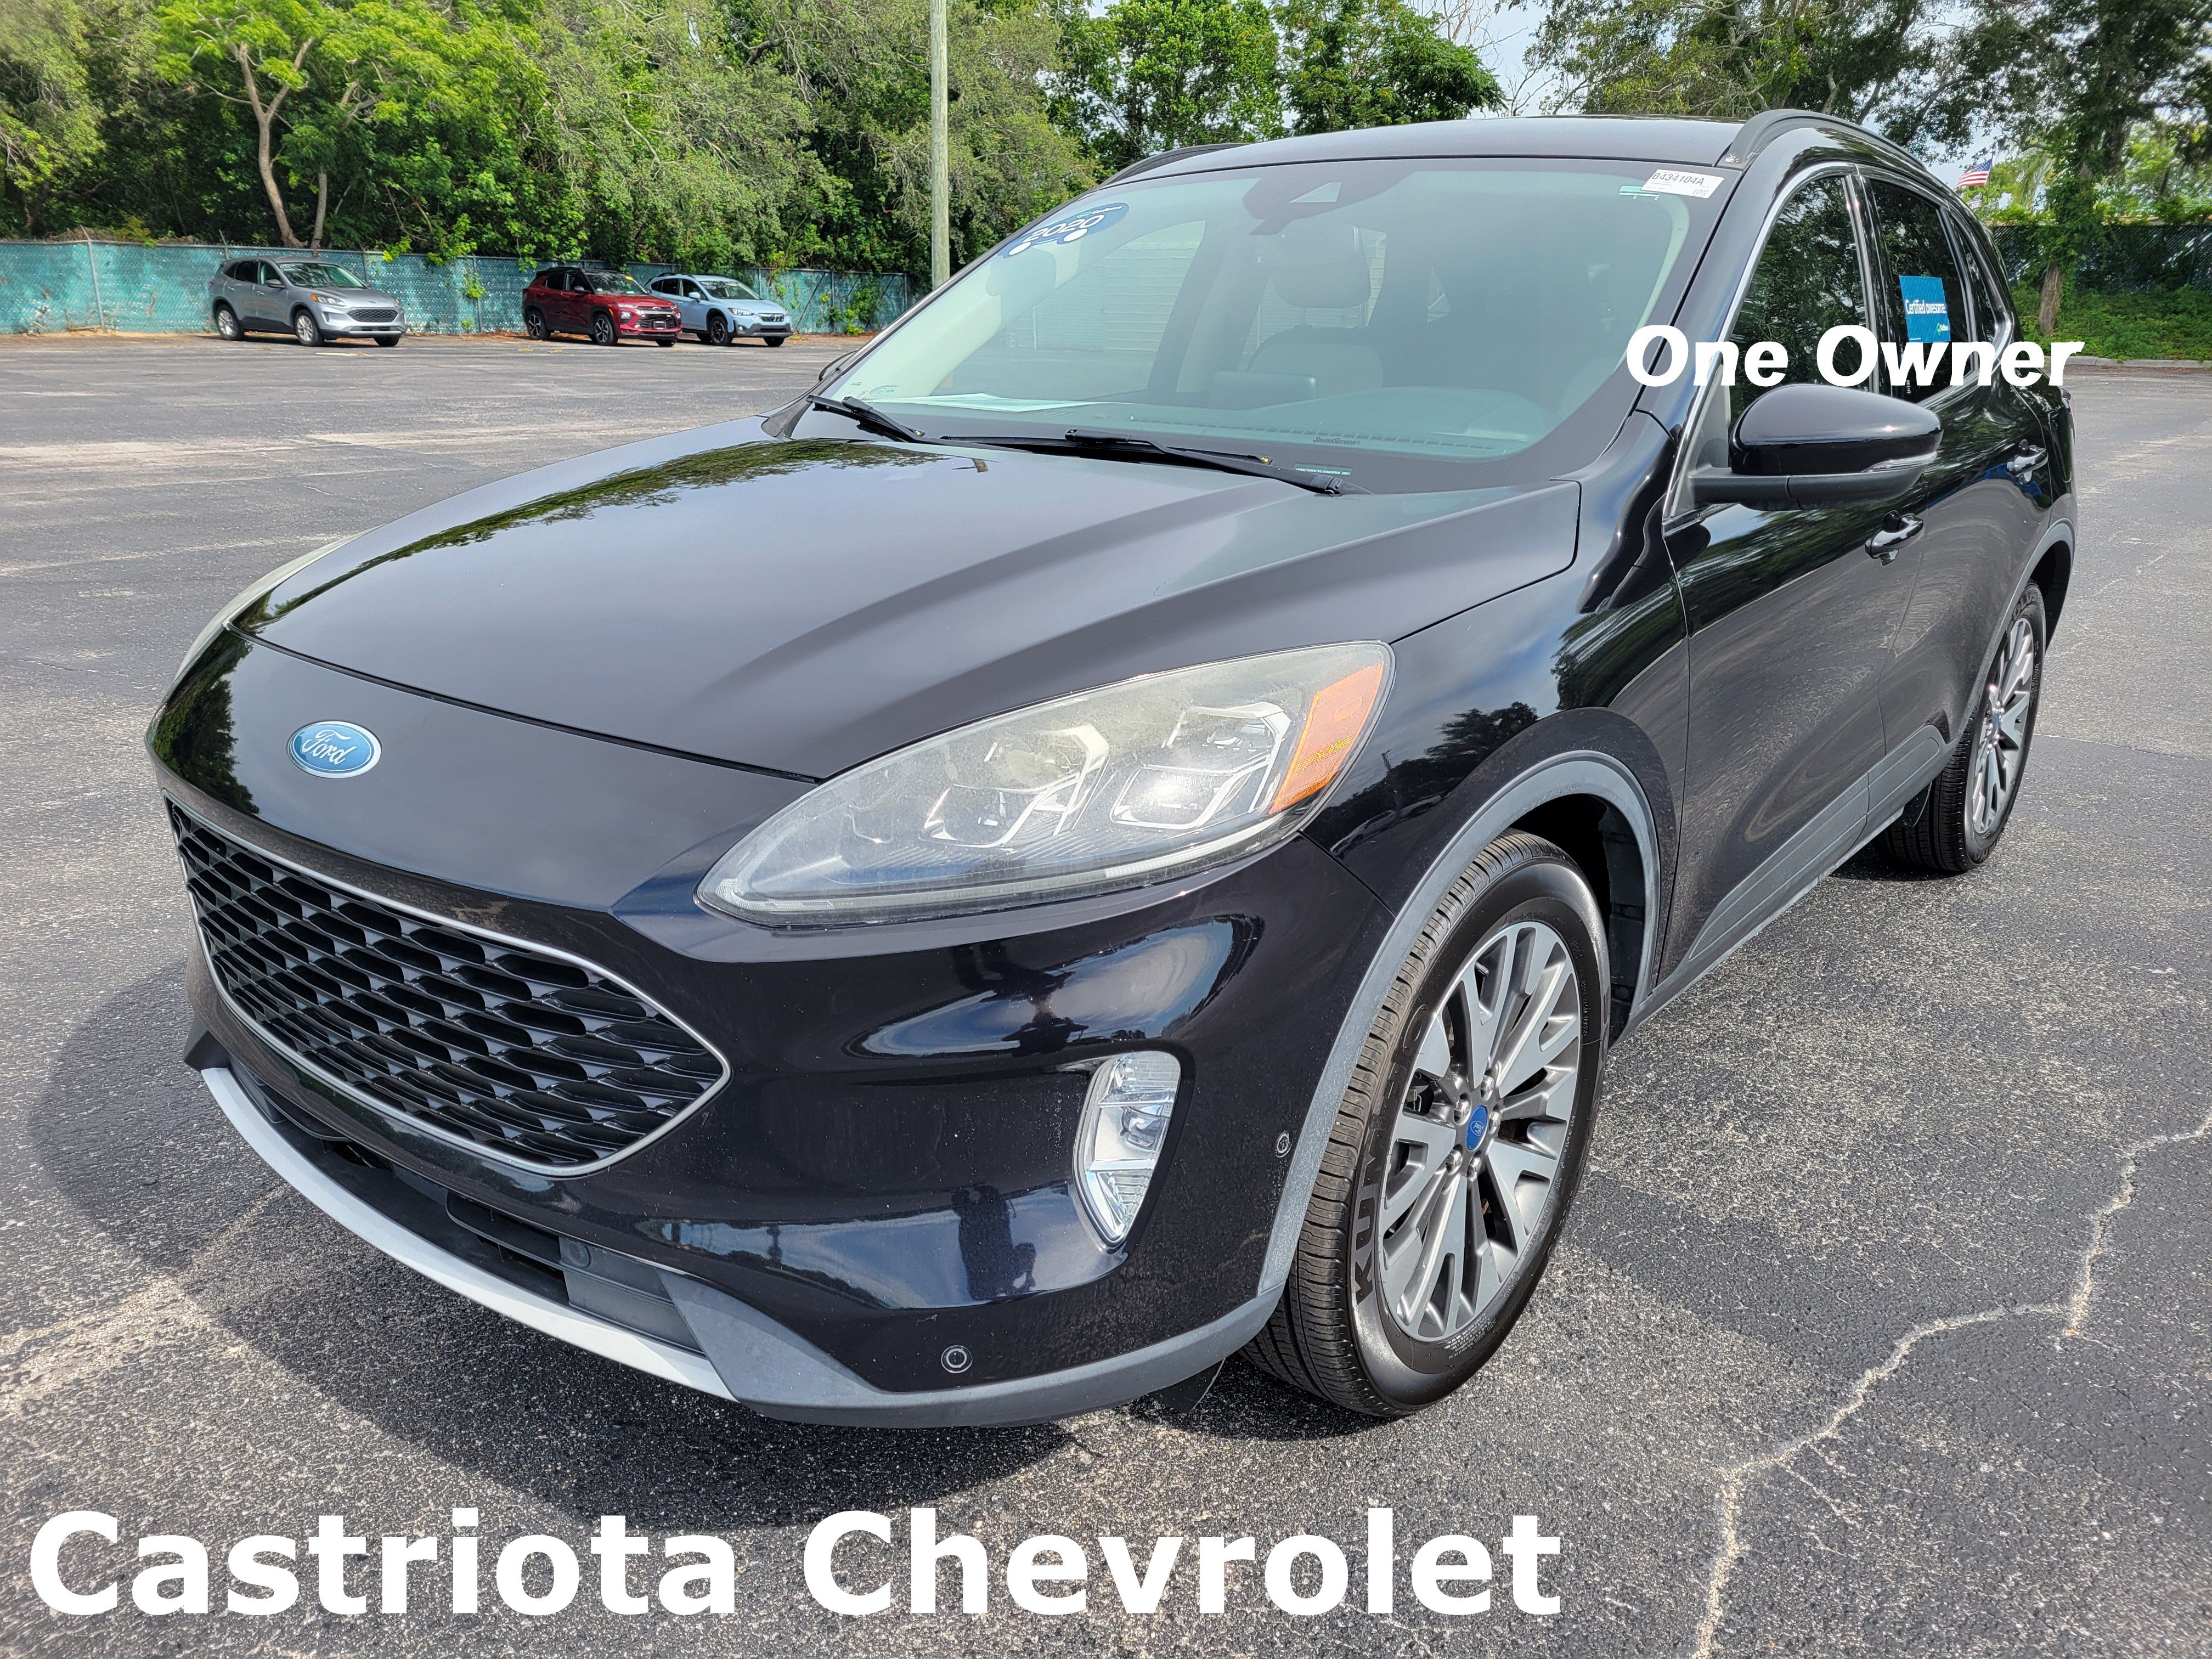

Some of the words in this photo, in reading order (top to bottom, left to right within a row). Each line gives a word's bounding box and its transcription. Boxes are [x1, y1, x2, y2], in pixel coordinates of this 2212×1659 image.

[1652, 173, 1705, 185] B434104A
[1022, 215, 1104, 243] 2020
[1905, 299, 1926, 315] Certified
[301, 729, 357, 764] Ford
